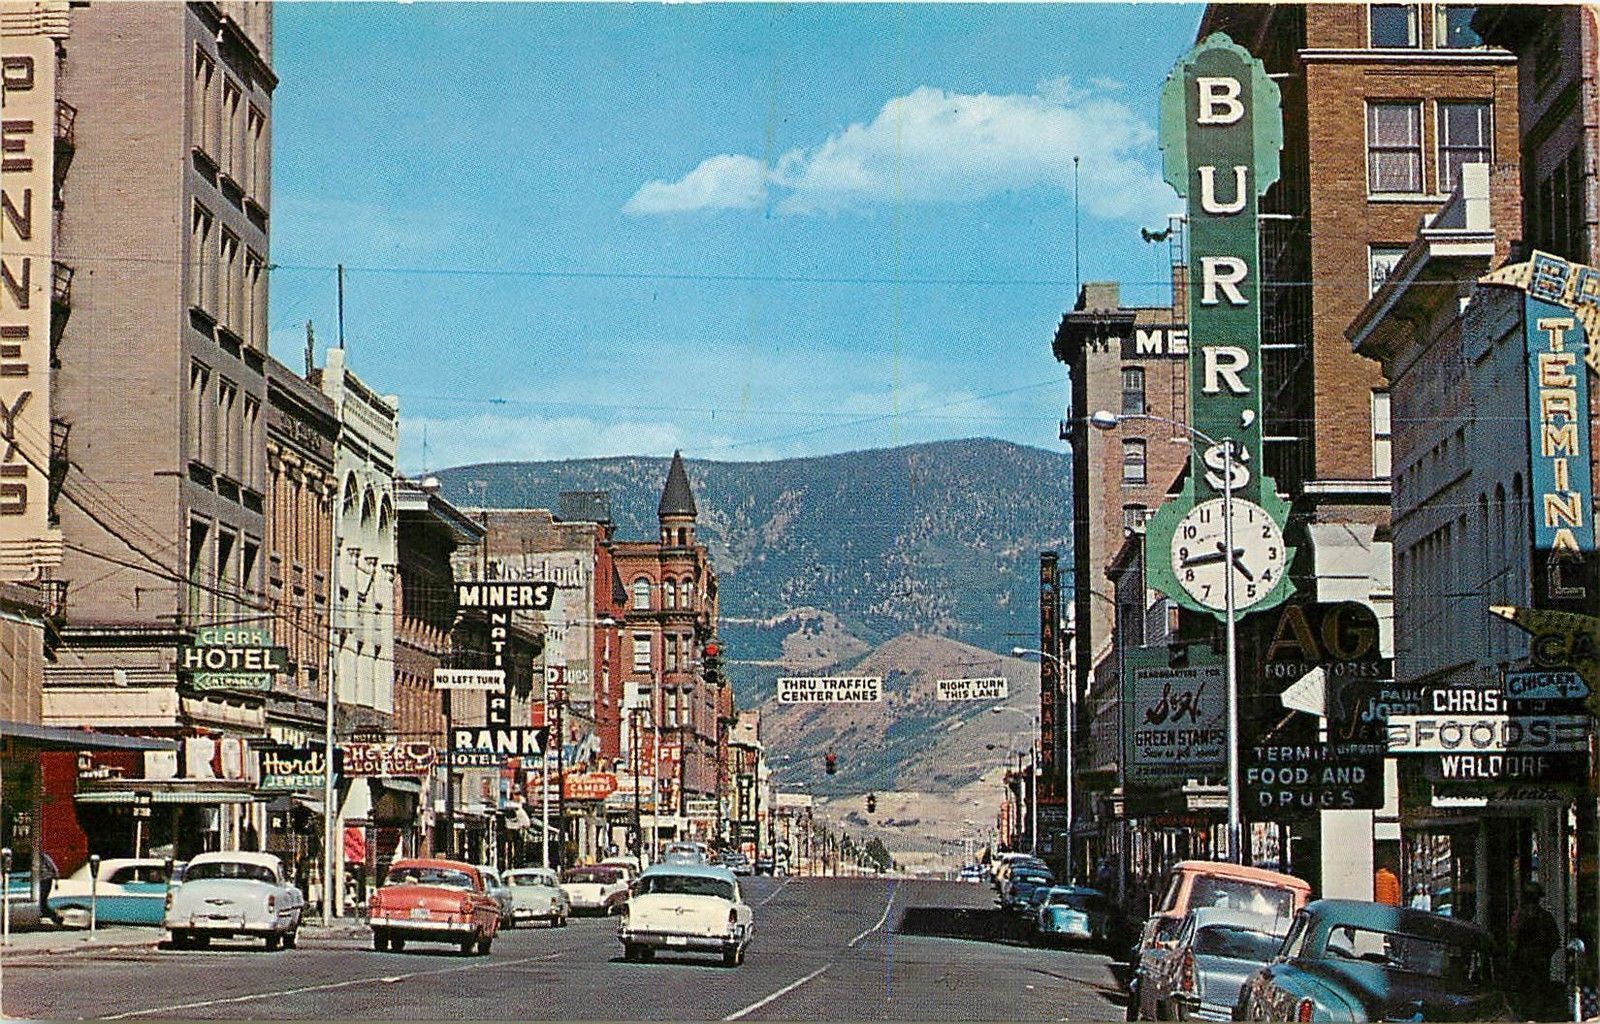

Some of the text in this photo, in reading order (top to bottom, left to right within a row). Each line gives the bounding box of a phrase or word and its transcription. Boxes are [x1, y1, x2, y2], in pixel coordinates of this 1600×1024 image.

[1195, 75, 1250, 490] BURR'S
[1537, 317, 1585, 598] TERMINAL
[1183, 525, 1197, 539] 10
[1262, 525, 1271, 538] 2
[1268, 547, 1277, 560] 3
[1185, 569, 1195, 581] 8
[1261, 568, 1272, 582] 4
[459, 585, 549, 606] MINERS
[1201, 584, 1211, 598] 7
[1247, 584, 1256, 597] 5
[202, 631, 263, 645] CLARK
[1267, 604, 1375, 660] AG
[182, 648, 280, 670] HOTEL
[436, 675, 501, 684] NO LEFT TURN
[783, 679, 877, 689] THRU TRAFFIC
[940, 680, 1004, 690] RIGHT TURN
[781, 690, 877, 701] CENTER LANES
[944, 689, 999, 699] THIS LANE
[1136, 730, 1224, 746] GREEN STAMPS
[1415, 720, 1551, 749] FOODS
[1440, 755, 1551, 777] WALDORF
[1247, 767, 1366, 785] FOOD AND
[569, 783, 611, 791] CAMERA
[1259, 791, 1355, 807] DRUGS
